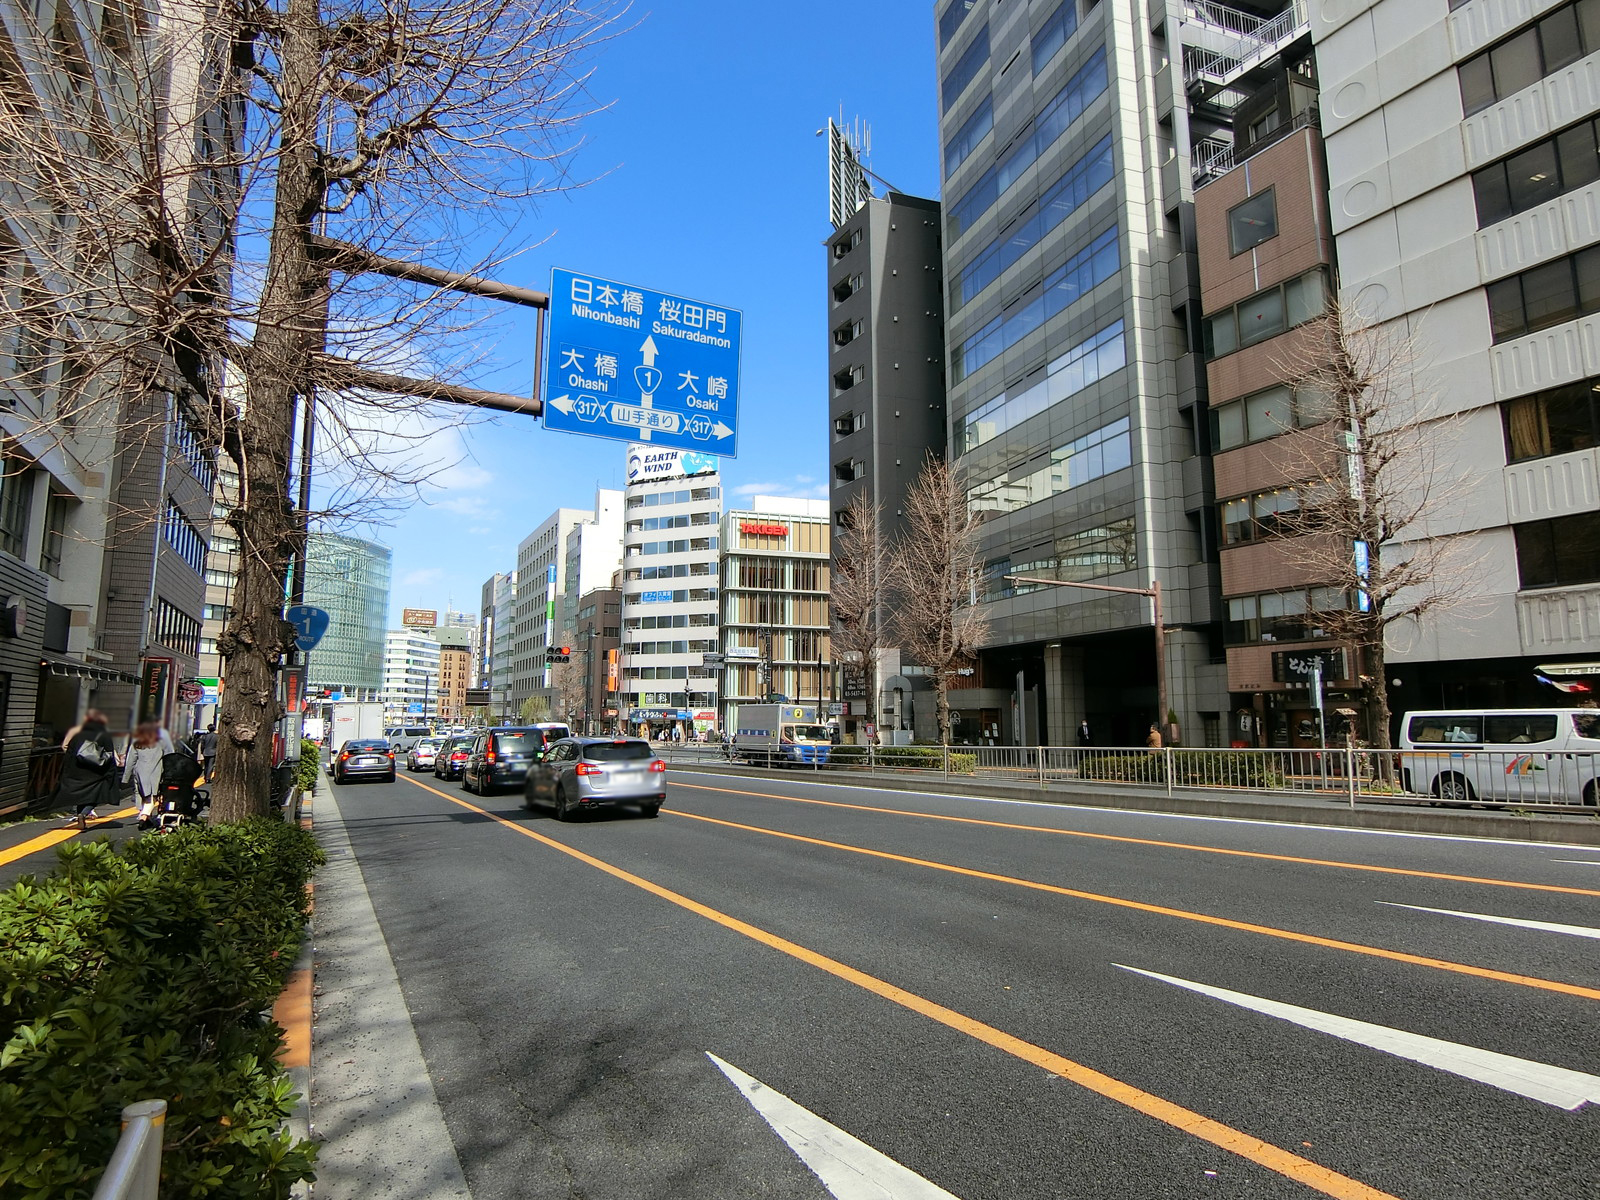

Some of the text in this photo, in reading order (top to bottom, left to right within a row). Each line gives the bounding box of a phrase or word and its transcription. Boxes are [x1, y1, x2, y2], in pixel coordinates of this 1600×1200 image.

[571, 277, 727, 334] 日本橋 桜田門
[571, 303, 731, 349] Nihonbashi Sakuradamon
[568, 373, 609, 392] Ohashi
[644, 371, 652, 387] 1
[577, 400, 598, 416] 317
[686, 394, 719, 412] Osaki
[617, 407, 673, 429] 山手通り
[692, 419, 711, 434] 317
[644, 451, 678, 464] EARTH
[644, 462, 673, 473] WIND
[741, 523, 789, 536] TAKIGEN
[302, 617, 311, 634] 1
[957, 667, 975, 676] Hug's
[645, 693, 668, 704] 歯科
